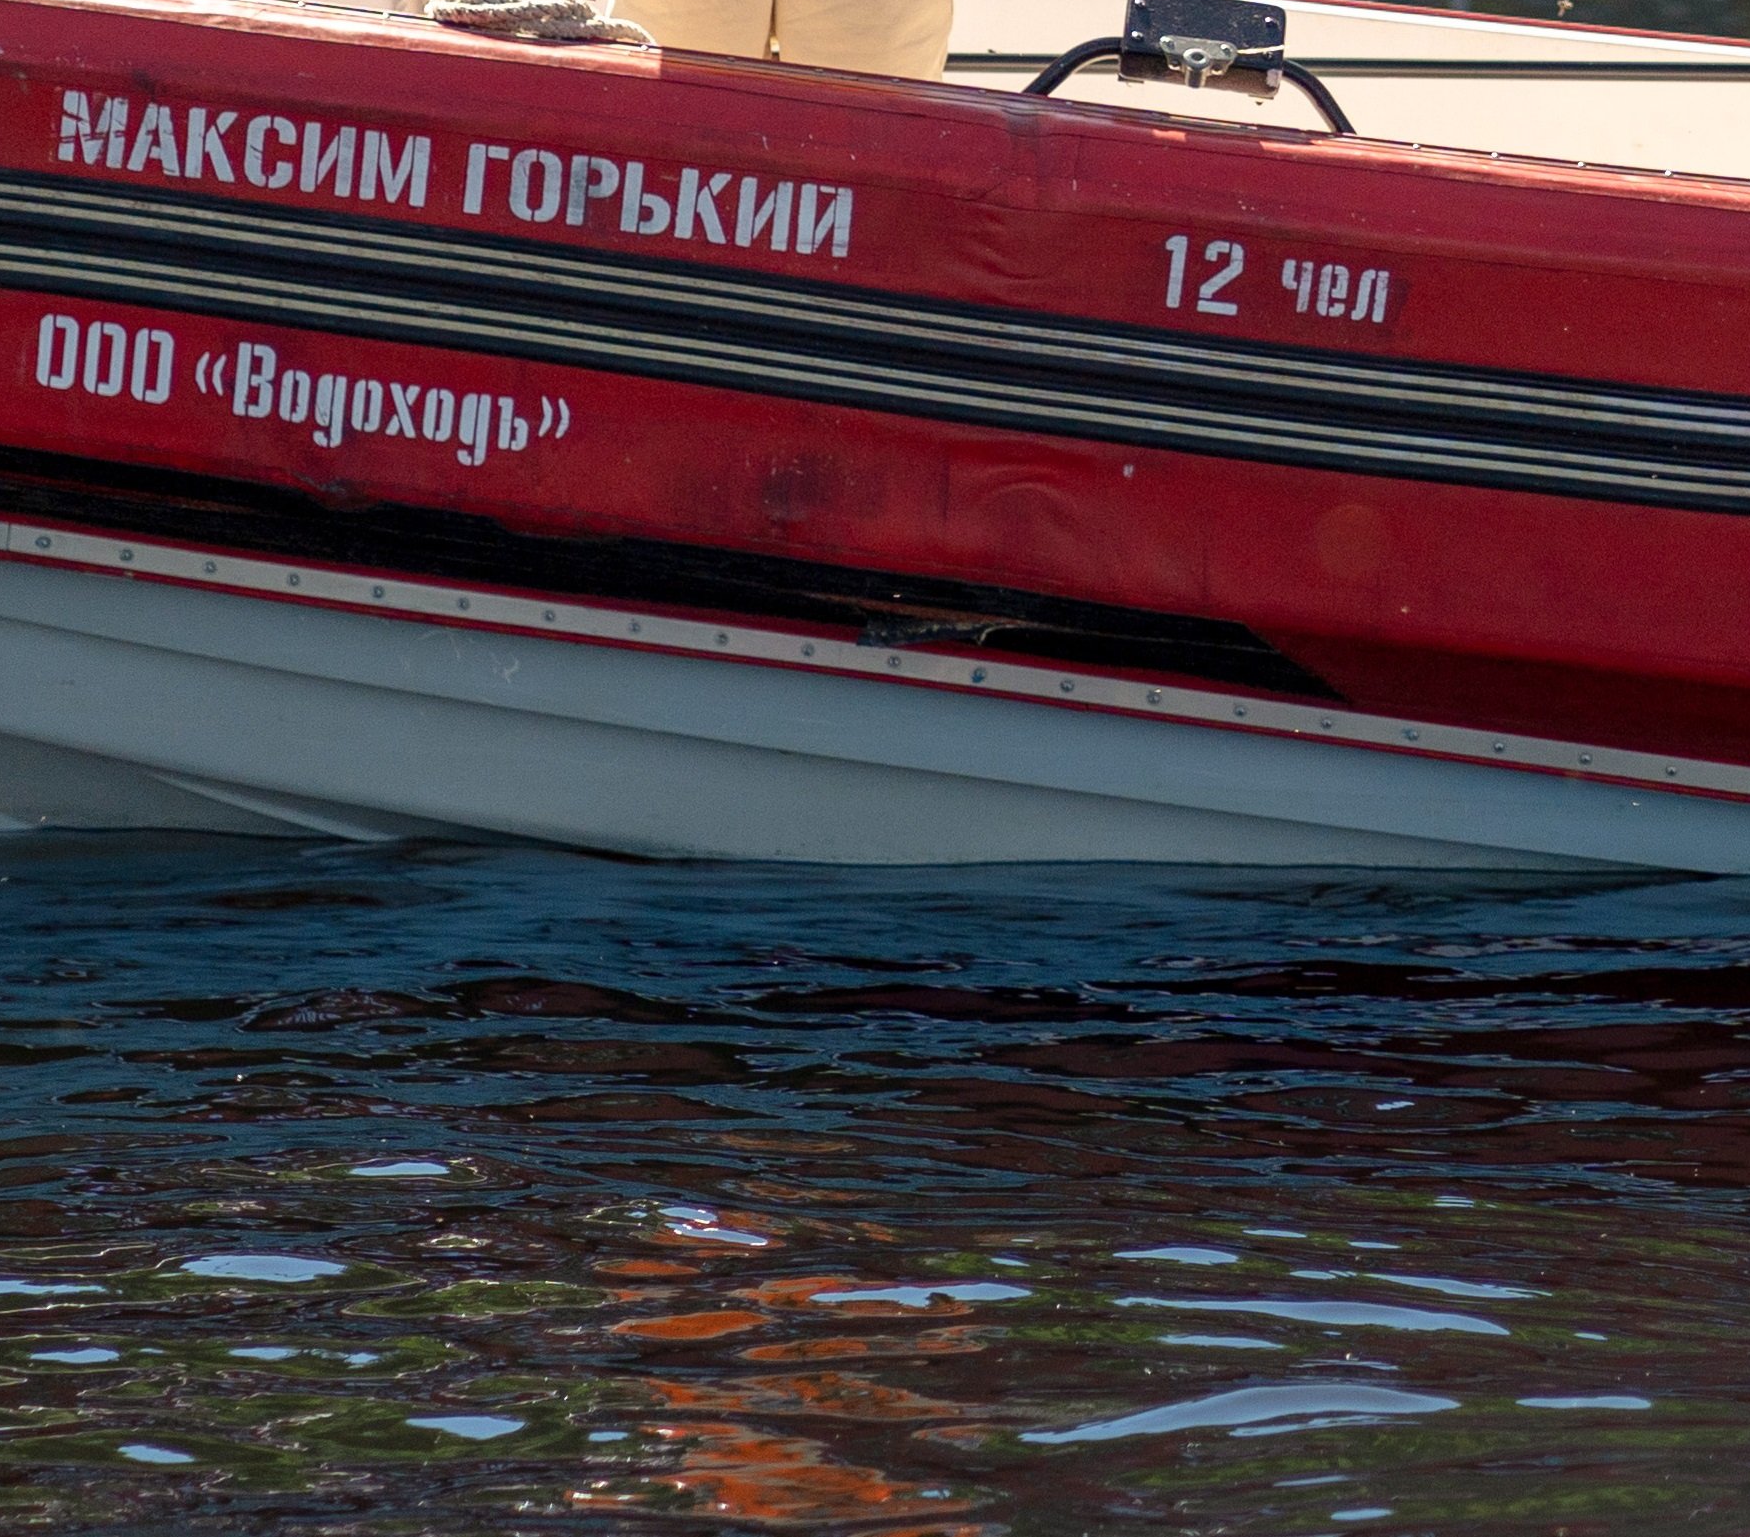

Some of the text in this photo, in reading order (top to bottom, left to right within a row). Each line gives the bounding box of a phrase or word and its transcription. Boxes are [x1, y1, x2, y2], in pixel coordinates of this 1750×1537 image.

[57, 89, 853, 258] МАКСИМ ГОРЬКИЙ
[1165, 235, 1389, 323] 12 чел
[36, 314, 174, 404] ООО
